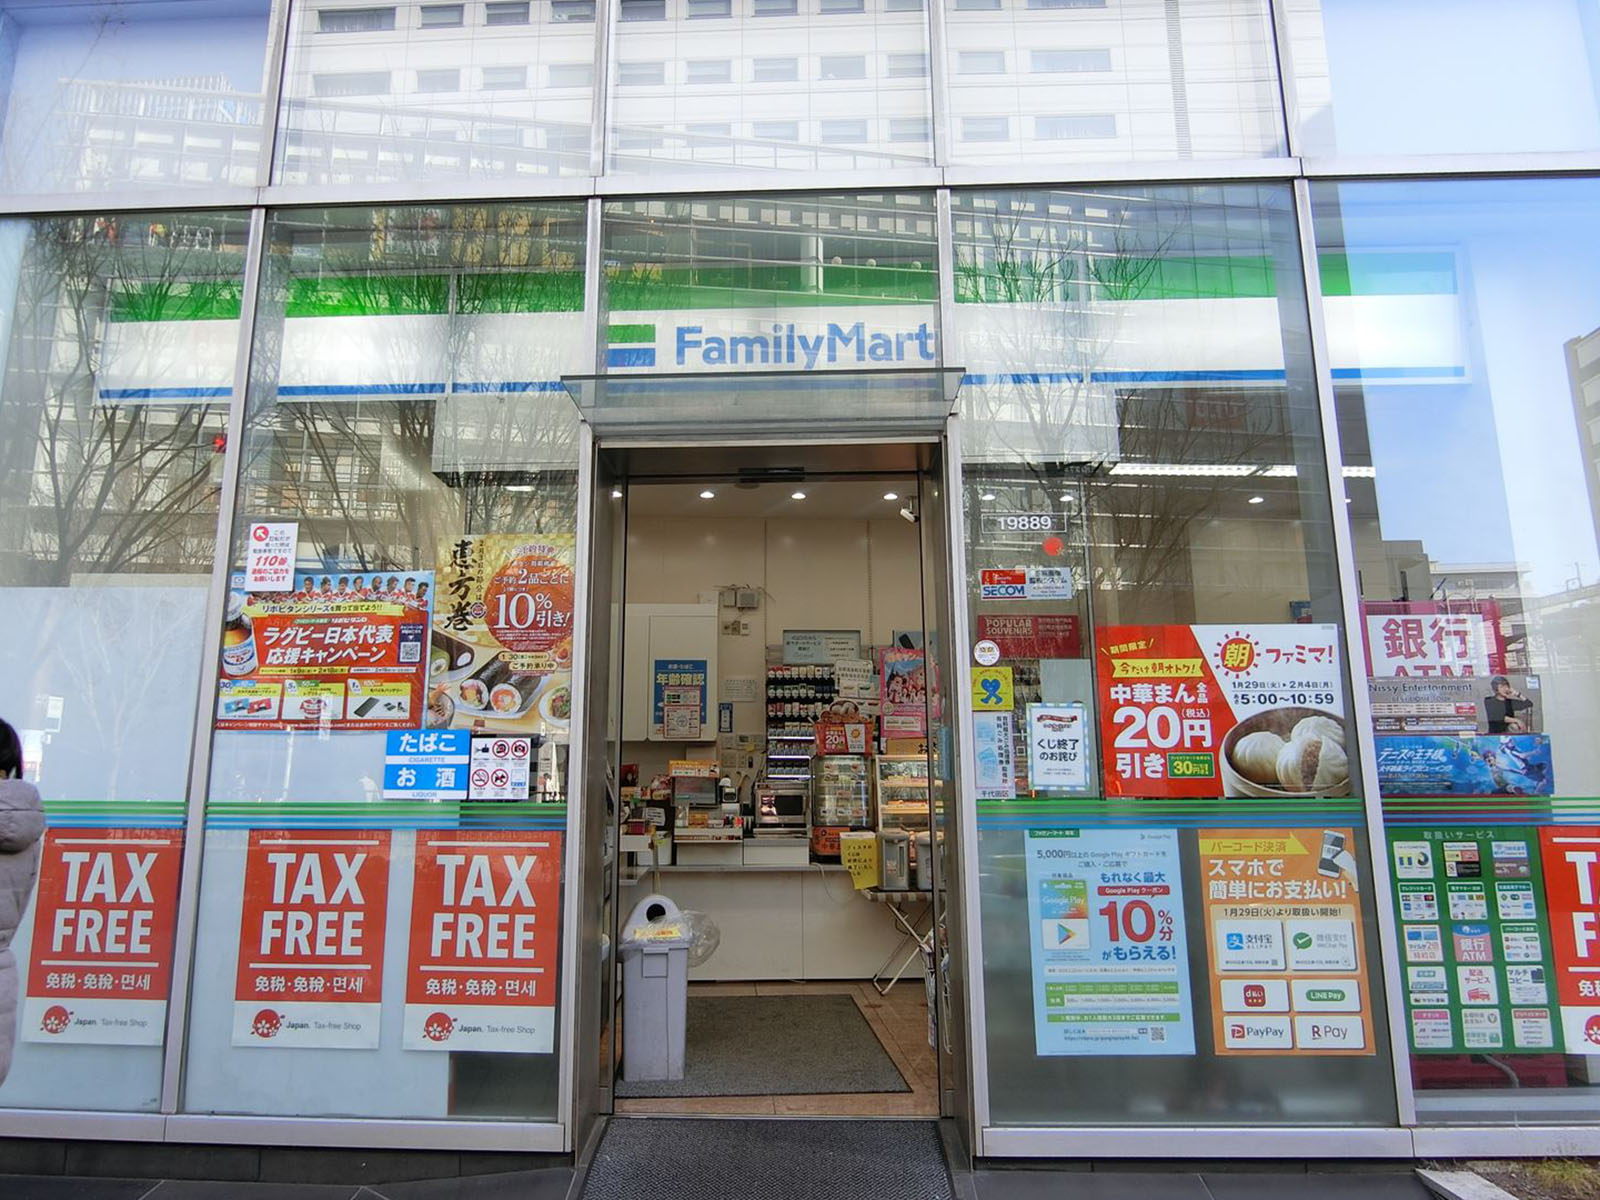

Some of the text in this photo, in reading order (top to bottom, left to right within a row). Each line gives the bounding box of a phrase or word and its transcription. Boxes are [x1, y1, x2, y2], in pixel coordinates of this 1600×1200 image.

[676, 323, 935, 369] FamilyMart
[1000, 516, 1051, 530] 19889
[983, 586, 1025, 596] SECOM
[986, 619, 1032, 627] POPULAR
[263, 625, 394, 645] ラグビー日本代表
[1382, 618, 1470, 660] 銀行
[266, 647, 386, 664] 応援キャンペーン
[1224, 644, 1334, 667] 朝 ファミマ!
[1369, 683, 1472, 694] Nissy Entertainment
[400, 733, 456, 752] たばこ
[1037, 739, 1079, 750] くじ終了
[1116, 753, 1165, 778] 引き
[1424, 830, 1495, 839] 取扱いサービス
[1211, 841, 1286, 852] バーコード決済
[1209, 859, 1284, 876] スマホで
[62, 852, 158, 903] TAX
[268, 853, 367, 904] TAX
[436, 855, 537, 907] TAX
[1101, 872, 1165, 883] もれなく最大
[1209, 881, 1347, 899] 簡単にお支払い!
[1224, 908, 1342, 917] 1月29日(火)より取扱い開始!
[52, 909, 153, 954] FREE
[260, 911, 364, 955] FREE
[431, 913, 536, 958] FREE
[1102, 946, 1176, 960] がもらえる!
[1463, 952, 1486, 960] ATM
[1310, 992, 1342, 1001] LINE Pay
[314, 1022, 341, 1030] Tax-free
[344, 1022, 361, 1031] Shop
[487, 1025, 515, 1033] Tax-free
[517, 1026, 536, 1034] Shop
[1247, 1027, 1284, 1038] PayPay
[1325, 1026, 1348, 1039] Pay
